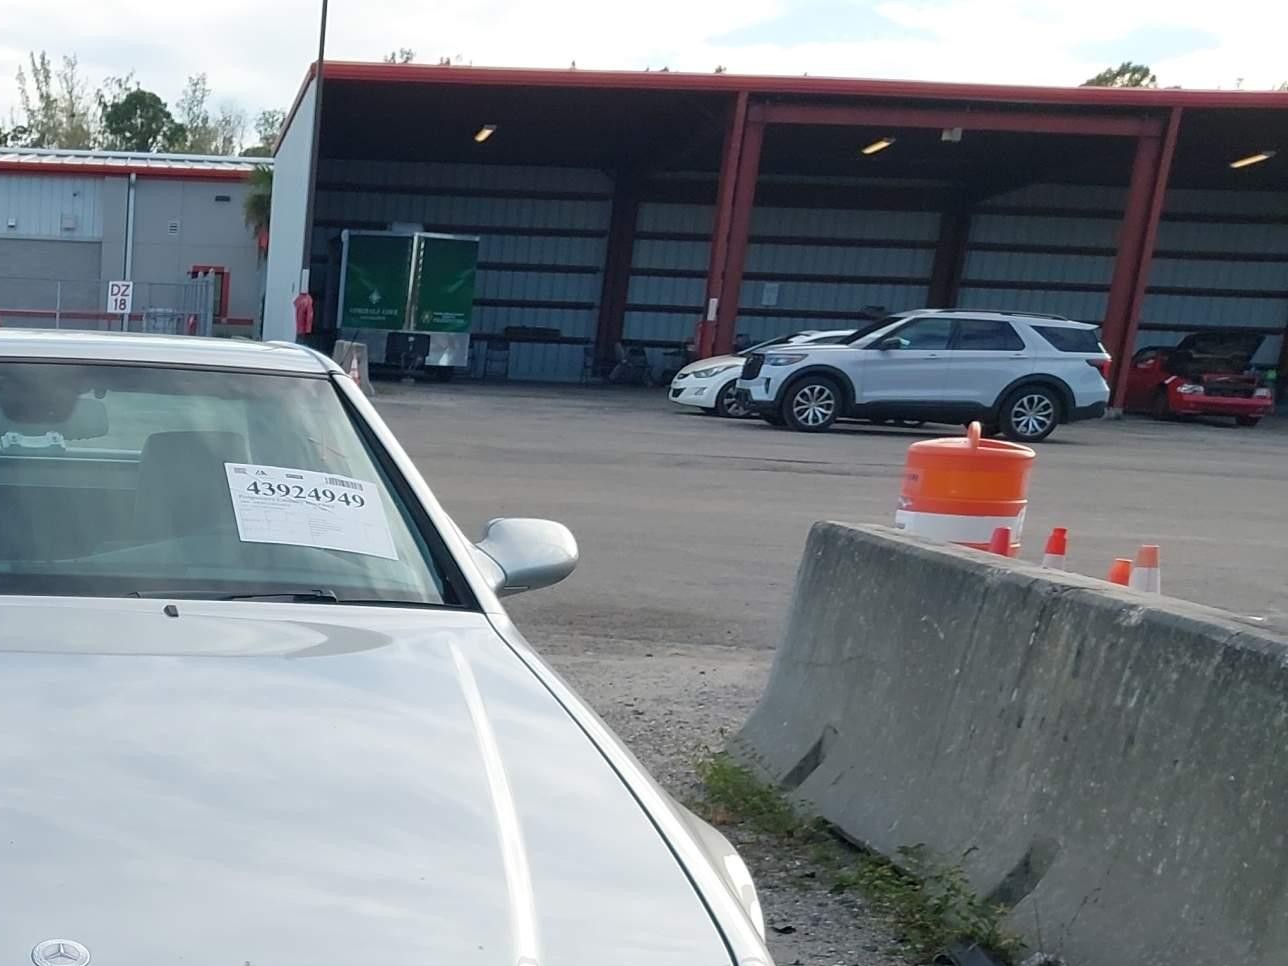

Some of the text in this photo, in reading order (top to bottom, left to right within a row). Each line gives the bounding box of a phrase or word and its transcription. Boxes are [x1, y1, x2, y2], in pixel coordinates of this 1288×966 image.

[110, 284, 130, 297] DZ
[113, 297, 127, 311] 18
[246, 480, 365, 508] 43924949
